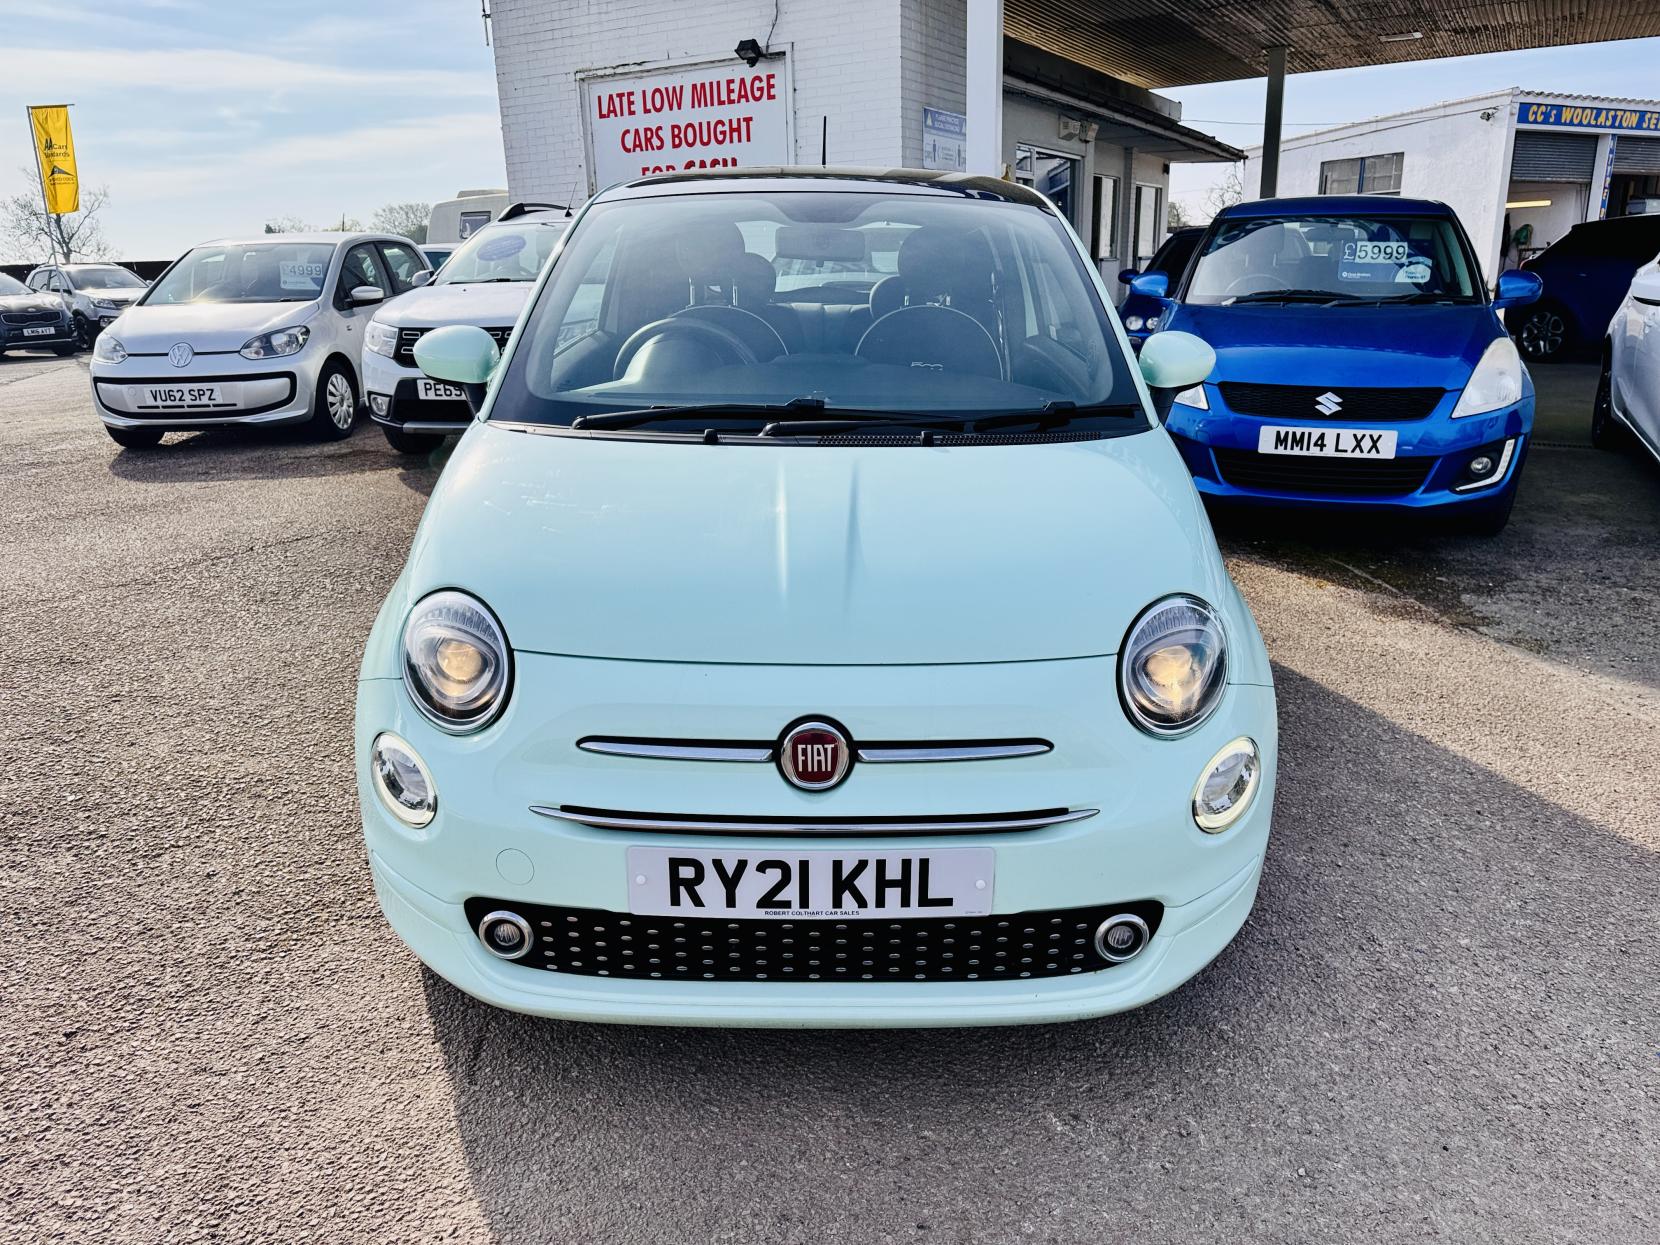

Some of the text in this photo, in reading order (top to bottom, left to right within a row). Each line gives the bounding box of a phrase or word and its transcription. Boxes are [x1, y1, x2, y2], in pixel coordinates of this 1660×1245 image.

[597, 73, 776, 119] LATE LOW MILEAGE
[1528, 104, 1660, 129] CC's WOOLASTON SE
[620, 116, 753, 153] CARS BOUGHT
[1343, 242, 1407, 260] £5999
[150, 388, 216, 402] VU62 SPZ
[1274, 430, 1383, 455] MM14 LXX
[797, 743, 835, 772] FIAT
[668, 857, 954, 910] RY21 KHL
